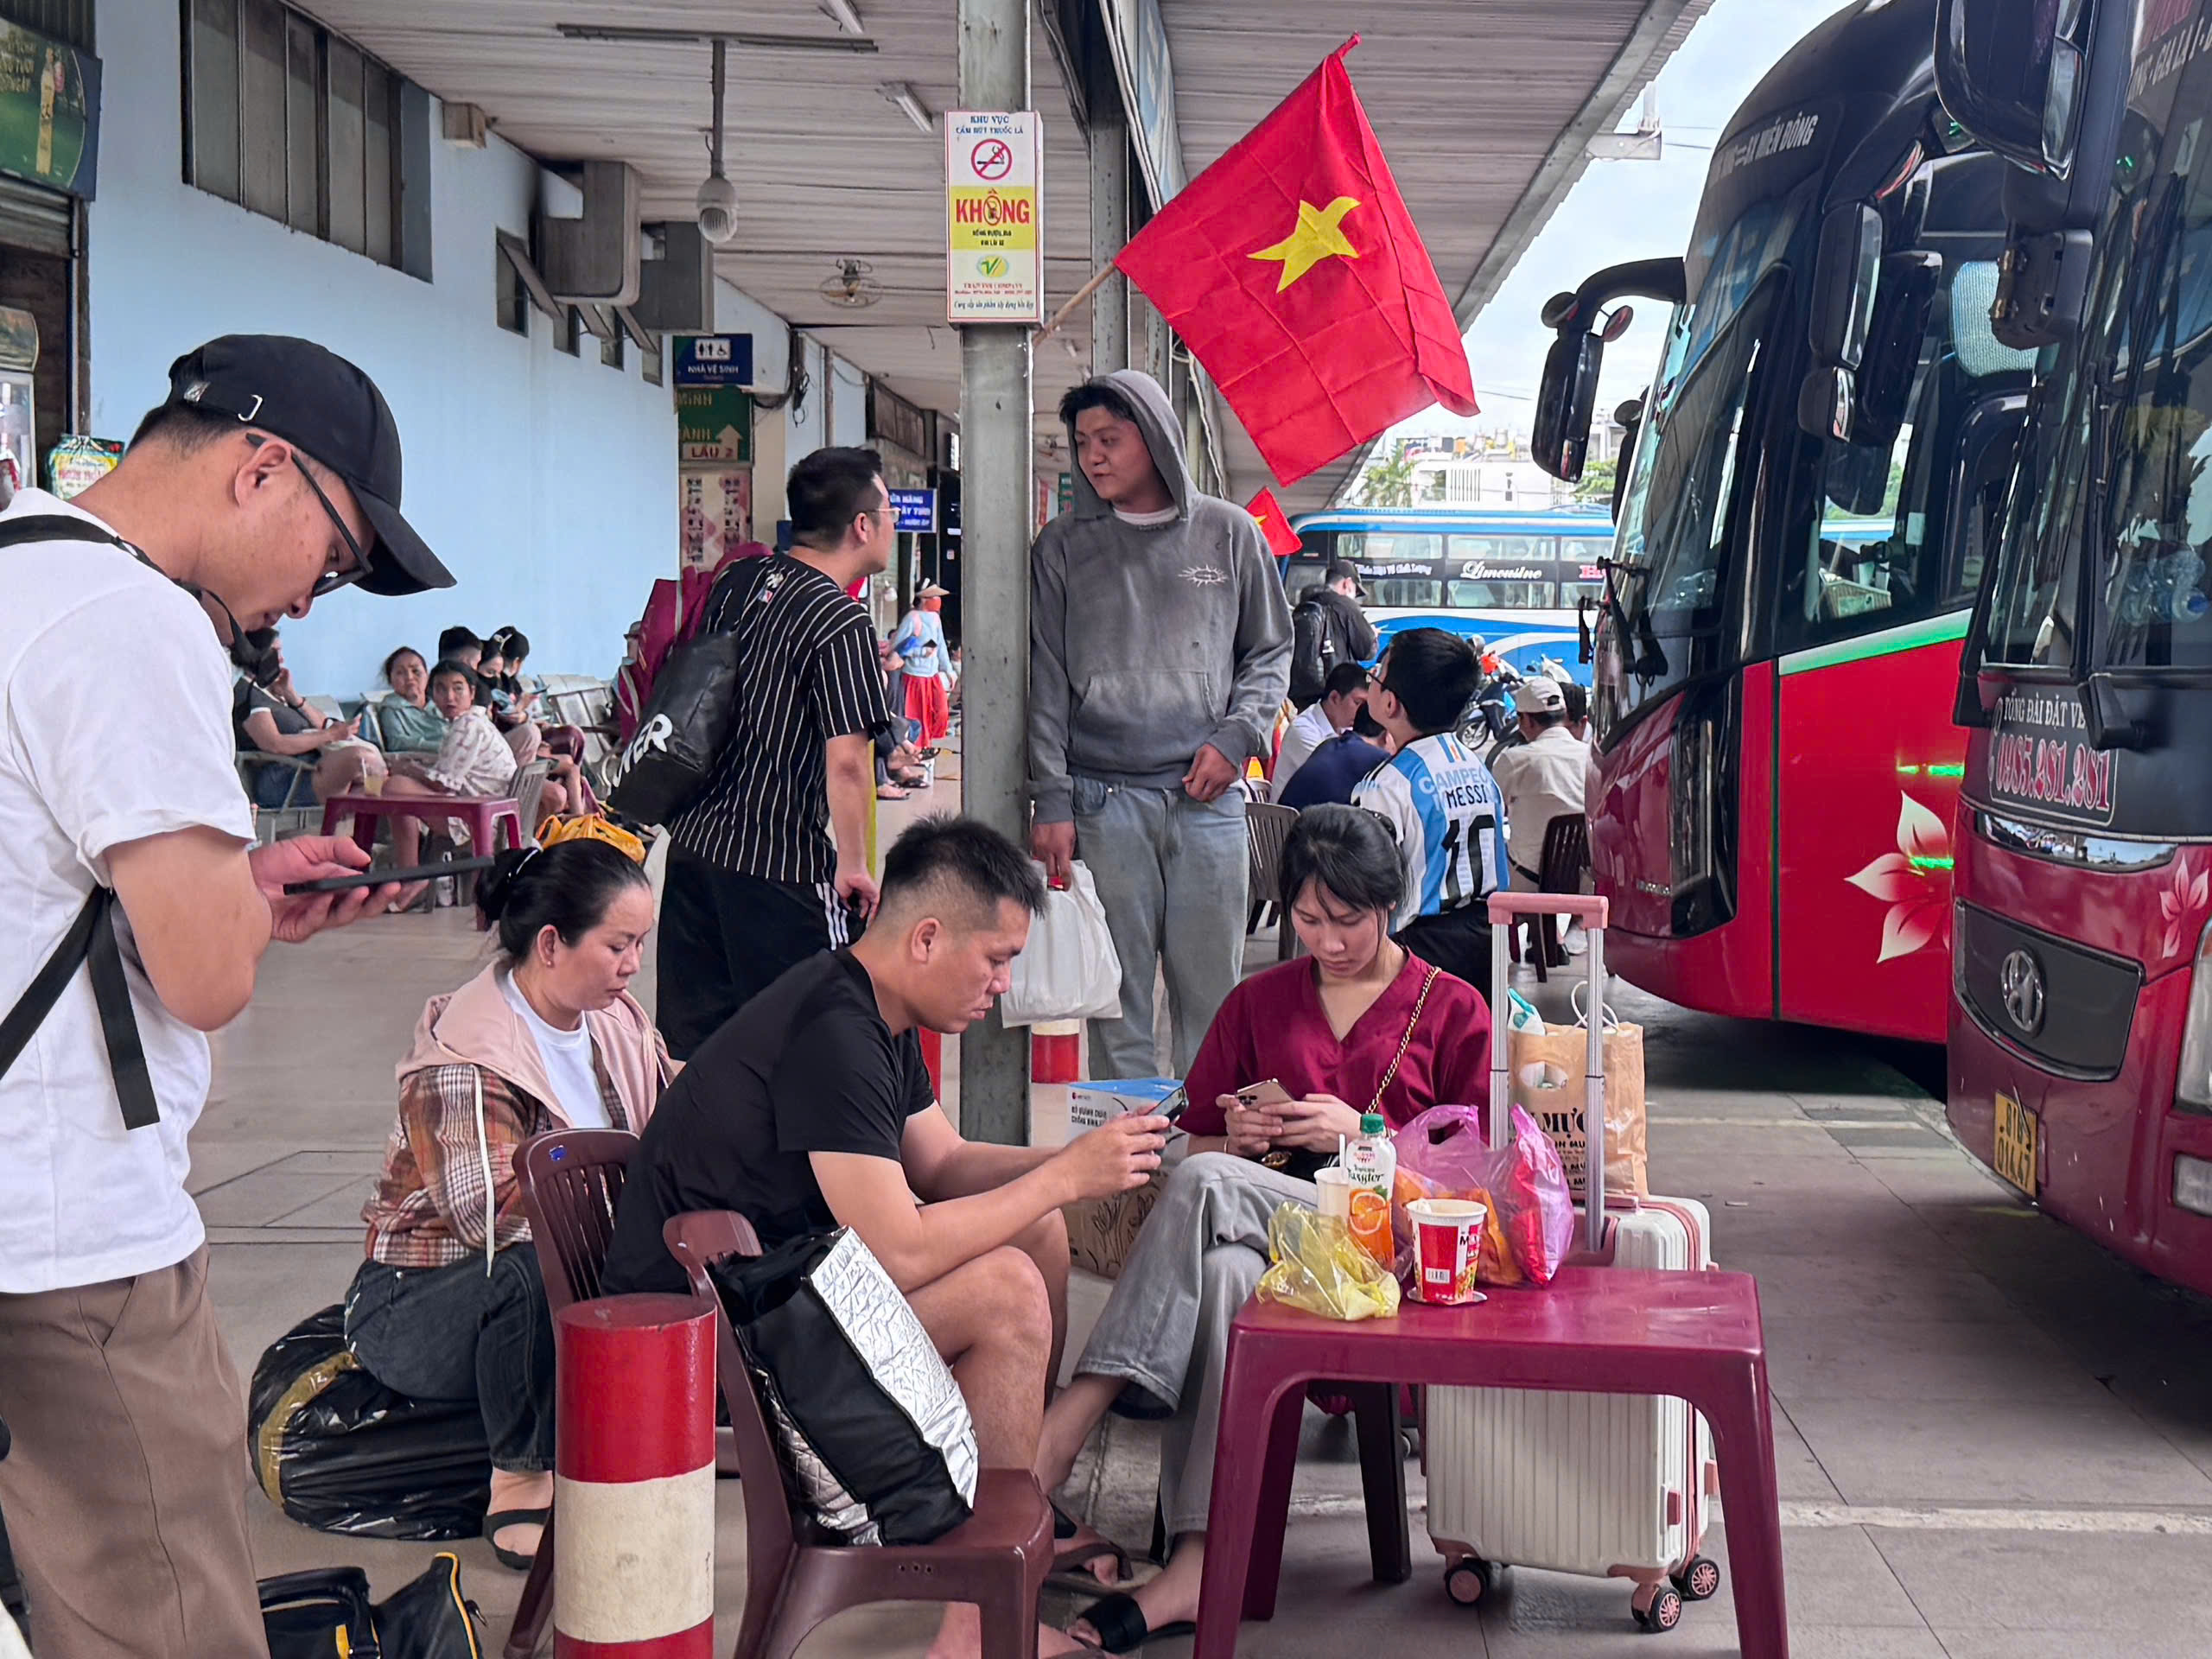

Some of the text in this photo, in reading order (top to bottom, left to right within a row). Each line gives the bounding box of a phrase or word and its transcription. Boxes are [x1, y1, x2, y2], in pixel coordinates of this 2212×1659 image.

[956, 188, 1030, 226] KHÔNG
[1460, 560, 1542, 579] Limousine
[2004, 687, 2026, 722] TỔNG
[2026, 691, 2044, 725] ĐÀI
[2044, 694, 2069, 731] ĐẶT
[1446, 784, 1488, 810] MESSI
[1440, 814, 1497, 903] 10
